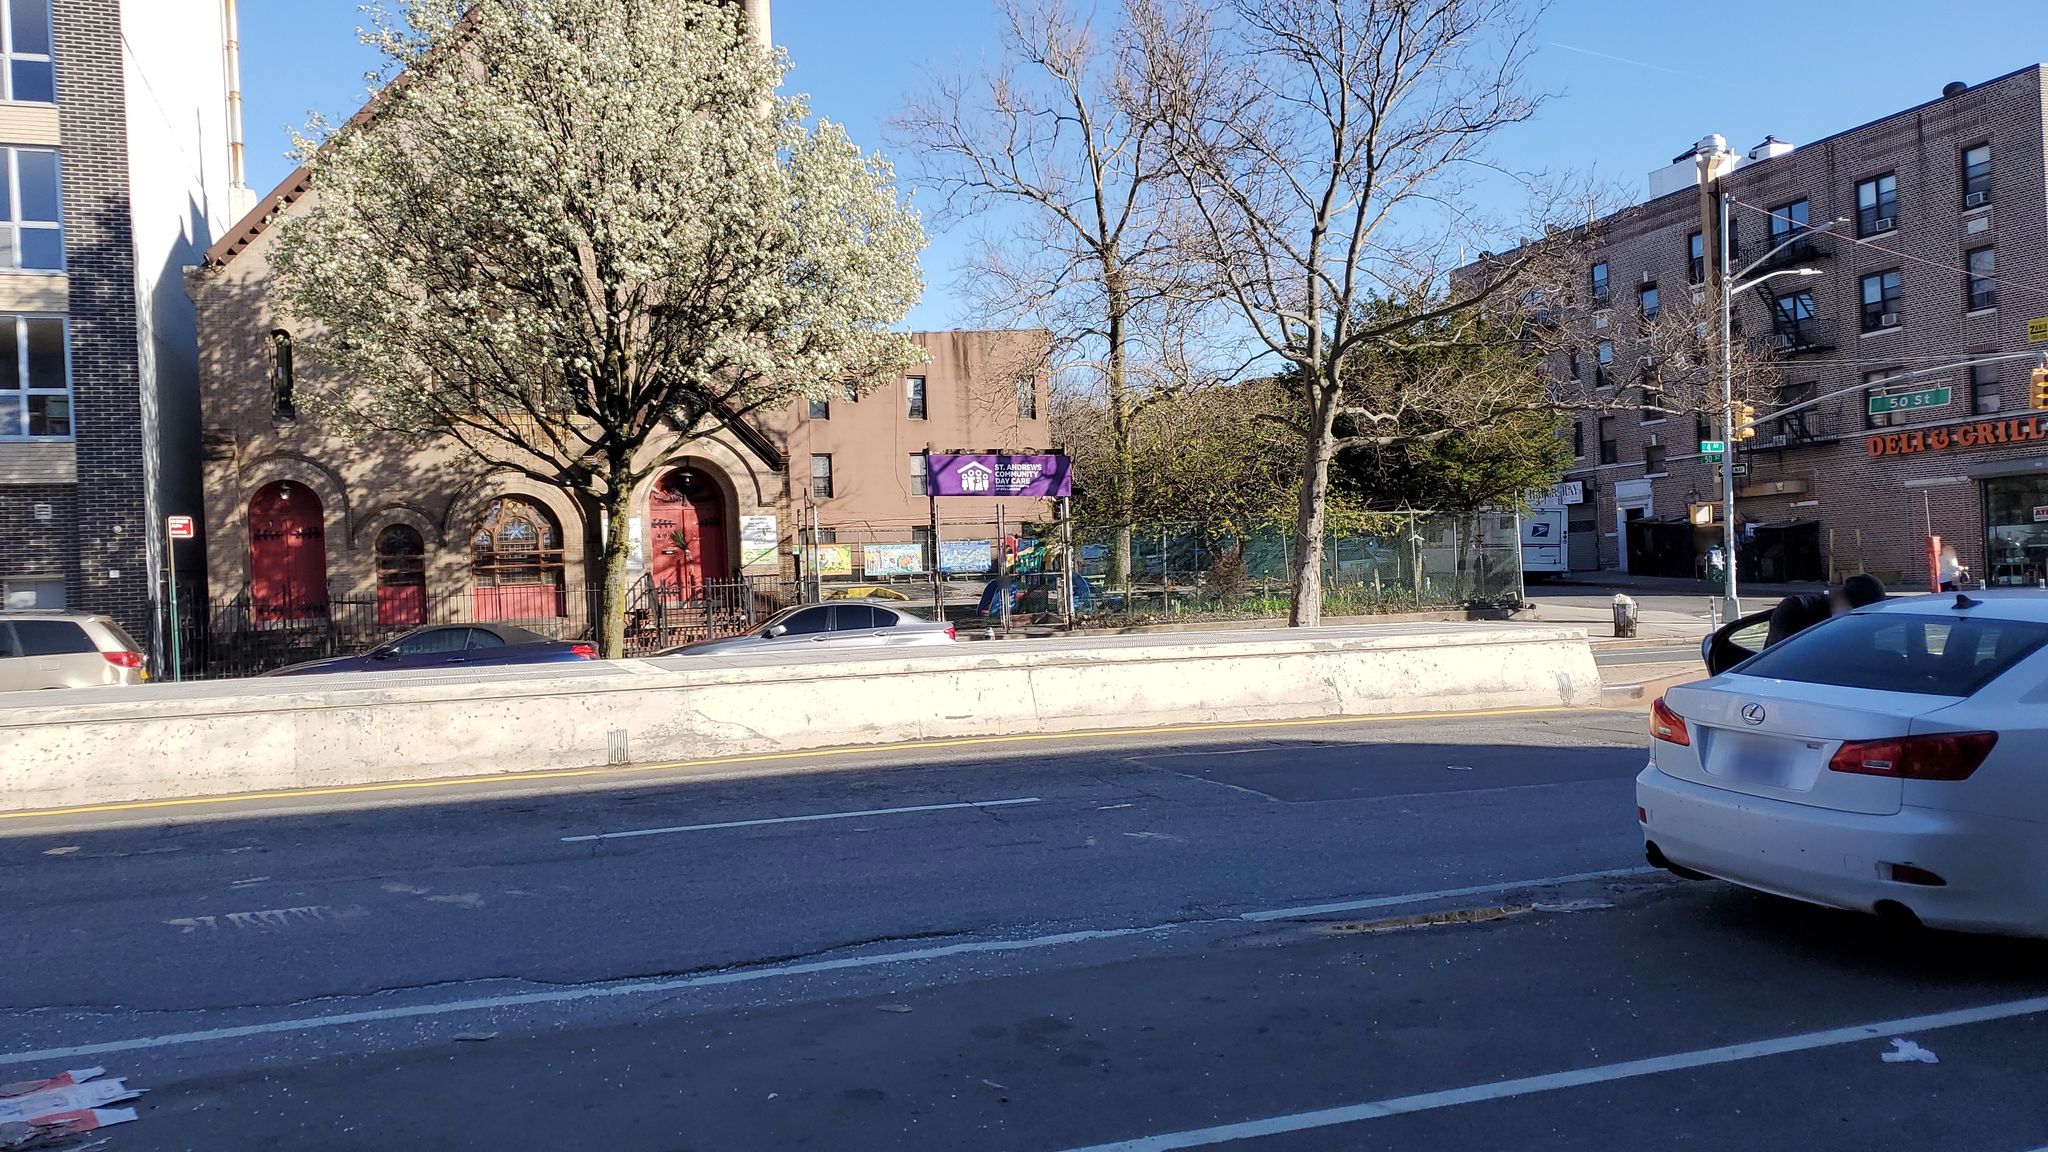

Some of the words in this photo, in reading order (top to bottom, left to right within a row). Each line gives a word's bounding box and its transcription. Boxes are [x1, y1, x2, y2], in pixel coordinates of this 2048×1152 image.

[1889, 397, 1908, 409] 50
[1914, 394, 1931, 405] St
[1867, 431, 1925, 457] DELI
[1930, 427, 1950, 449] &
[1956, 415, 2046, 447] GRILL
[1704, 455, 1713, 463] 50
[994, 463, 1006, 471] ST.
[1006, 463, 1042, 471] ANDREWS
[994, 470, 1039, 478] COMMUNITY
[995, 477, 1010, 485] DAY
[1010, 477, 1031, 485] CARE
